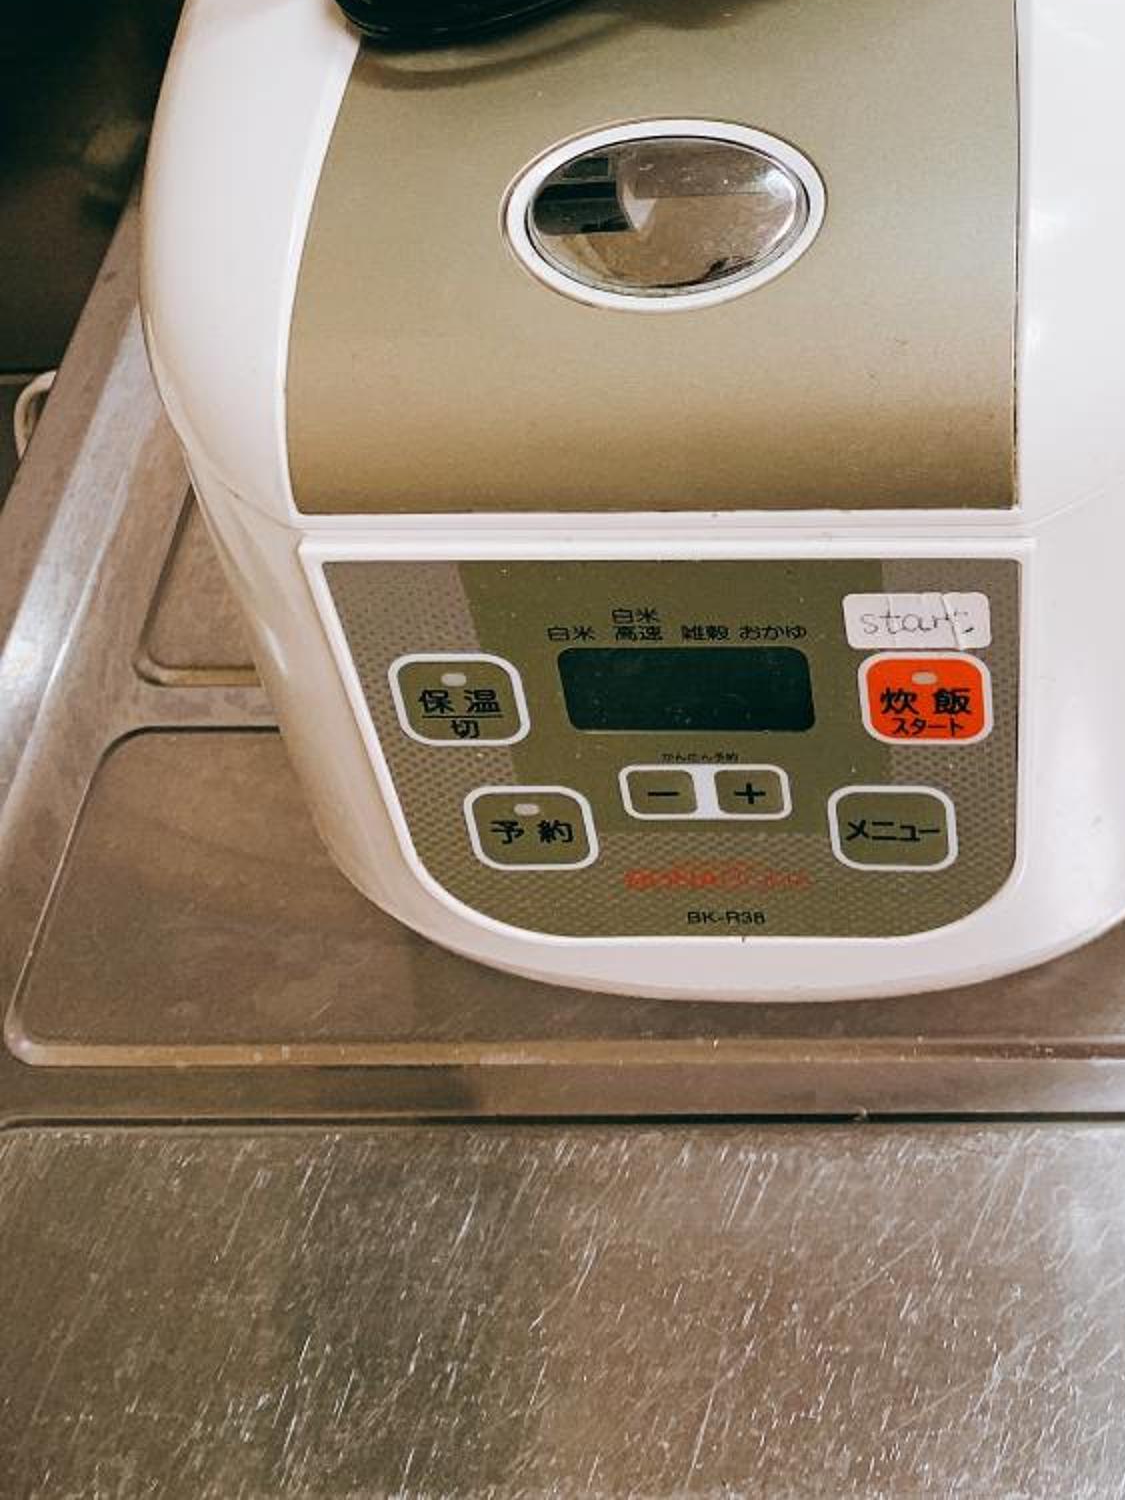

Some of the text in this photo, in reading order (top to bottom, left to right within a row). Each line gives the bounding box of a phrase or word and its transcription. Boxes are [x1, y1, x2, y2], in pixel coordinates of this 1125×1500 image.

[612, 608, 658, 624] 白米
[547, 625, 807, 641] 白米 高速 雑穀 おかゆ
[418, 689, 501, 714] 保温
[880, 687, 972, 715] 炊飯
[451, 719, 480, 739] 切
[891, 717, 965, 736] スタート
[490, 820, 574, 845] 予約
[847, 819, 940, 842] メニュー
